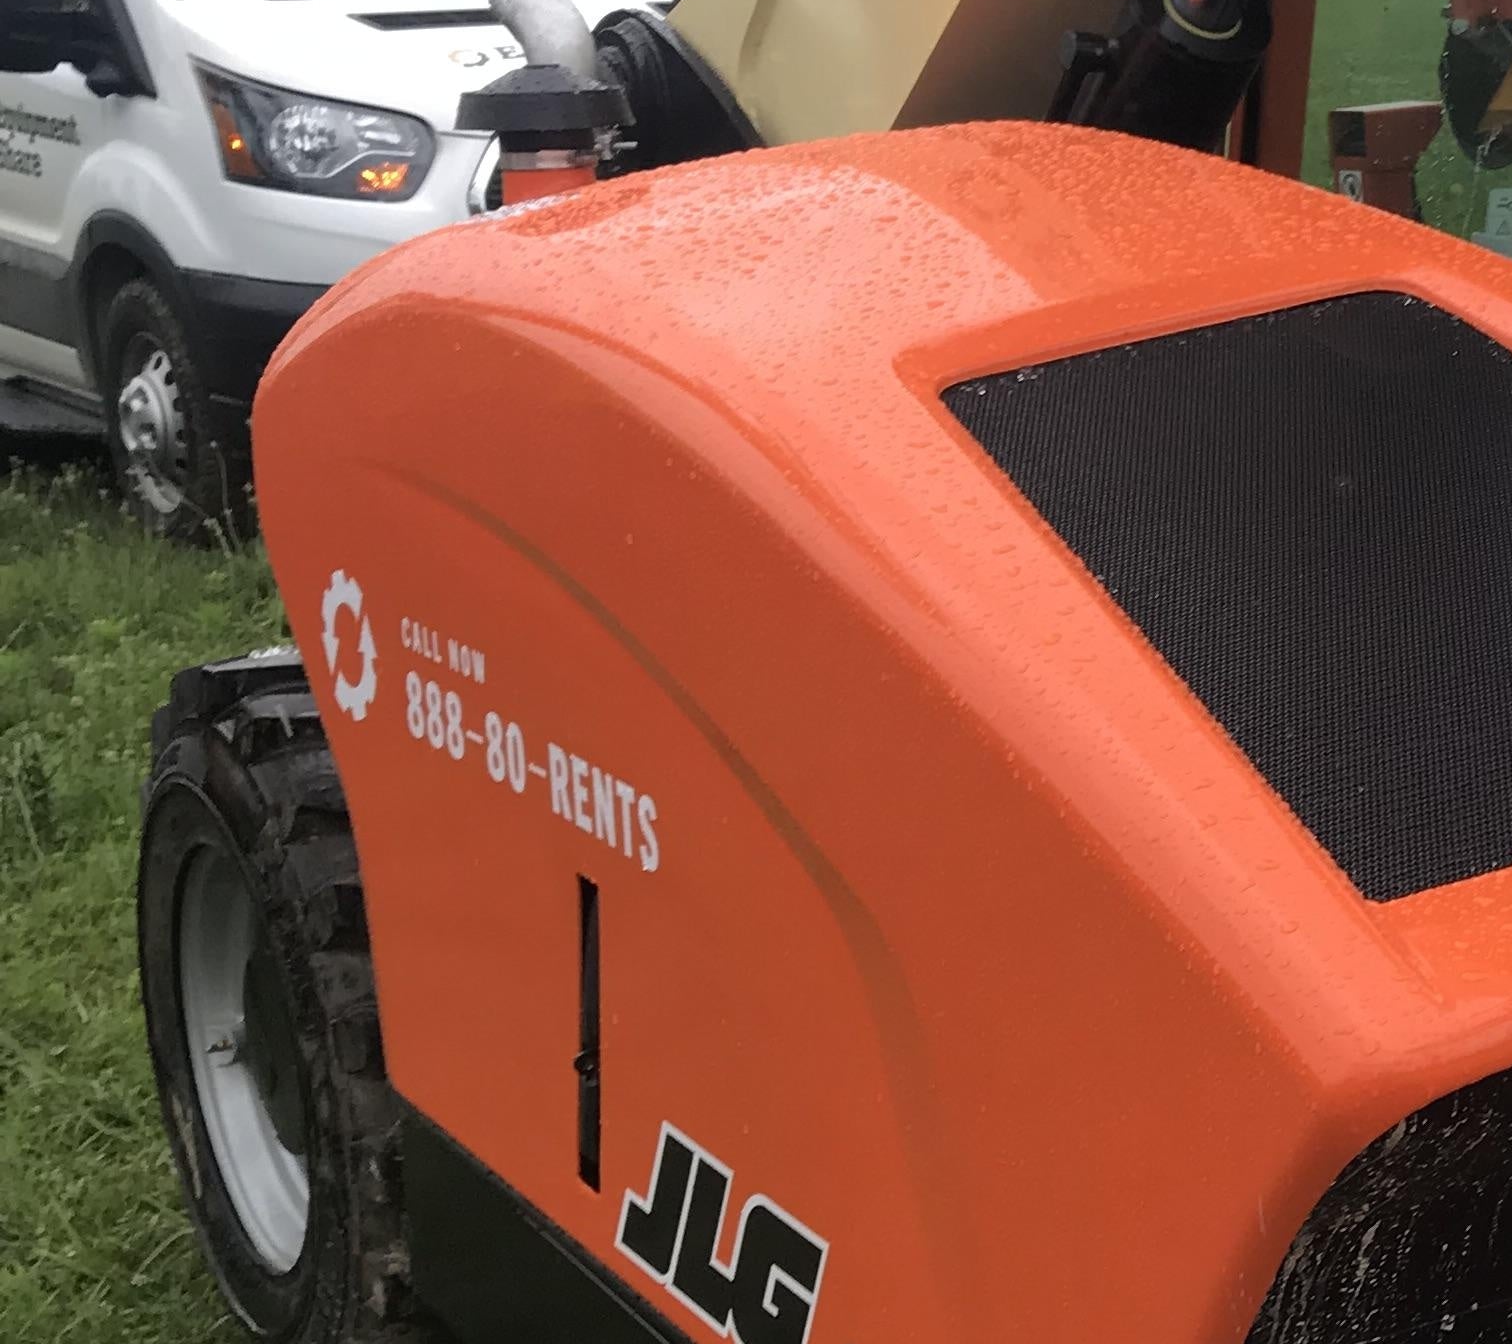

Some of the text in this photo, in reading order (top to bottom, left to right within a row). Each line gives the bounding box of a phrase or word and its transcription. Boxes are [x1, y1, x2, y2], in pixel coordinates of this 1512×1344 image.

[401, 616, 485, 684] CALL NOW
[405, 670, 660, 873] 888-80-RENTS
